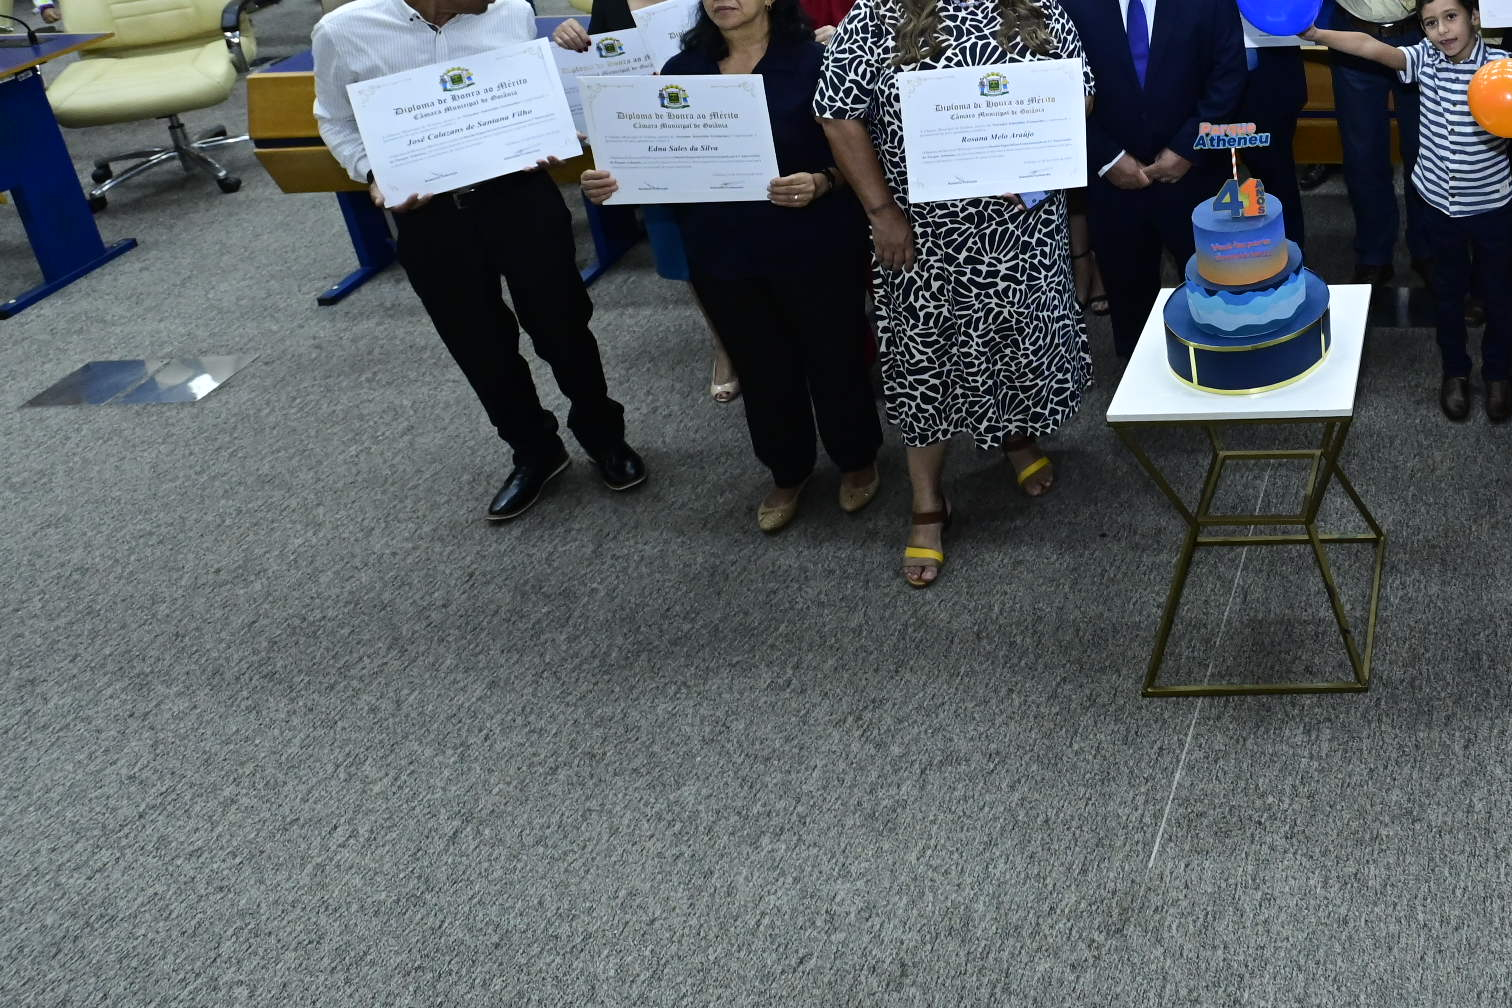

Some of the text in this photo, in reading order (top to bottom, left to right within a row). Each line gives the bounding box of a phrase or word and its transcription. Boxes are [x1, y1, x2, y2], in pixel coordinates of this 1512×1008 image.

[393, 101, 435, 115] Diploma
[936, 103, 971, 112] Diploma
[617, 112, 652, 120] Diploma
[407, 136, 425, 146] José
[427, 128, 464, 141] Calazans
[477, 115, 509, 127] Santana
[512, 109, 532, 118] Filho
[1199, 122, 1256, 134] Parque
[961, 136, 987, 144] Rosana
[1010, 131, 1034, 139] Araújo
[1194, 133, 1270, 149] Atheneu
[1213, 178, 1260, 218] 41
[1256, 180, 1265, 214] ANOS
